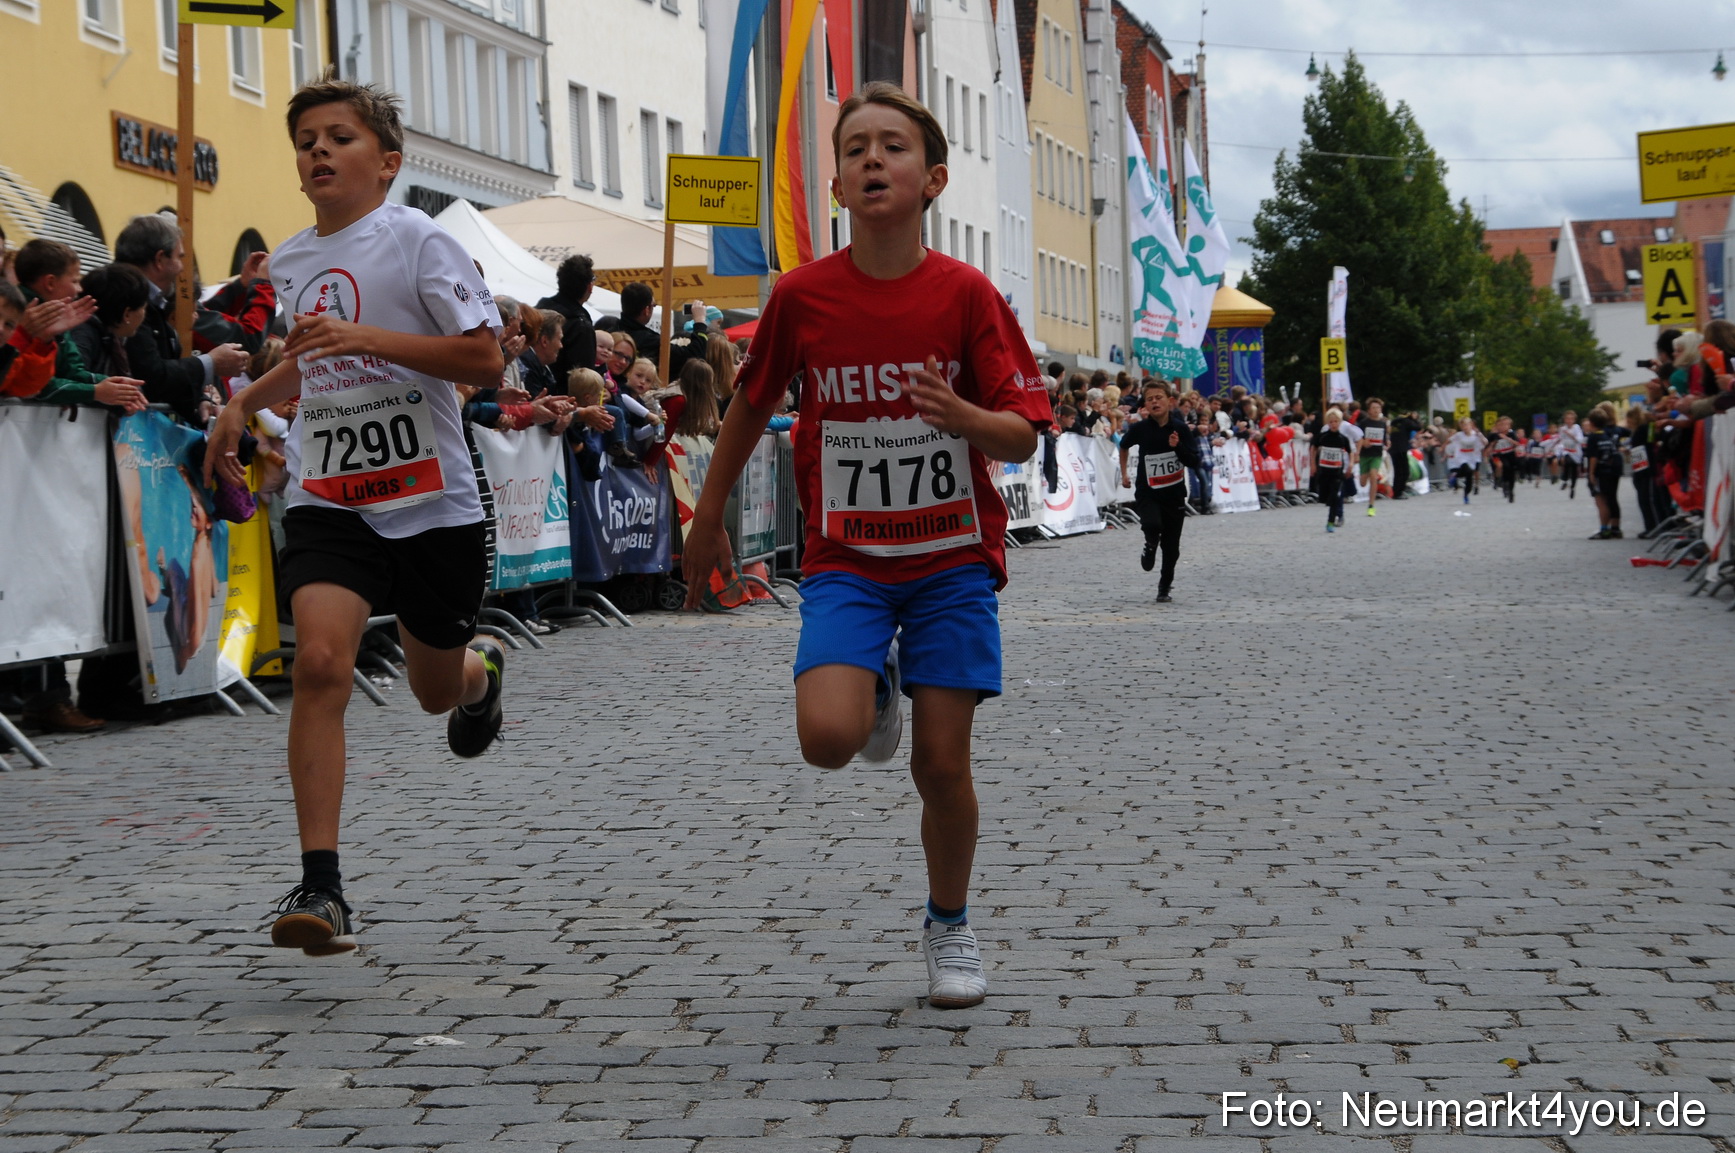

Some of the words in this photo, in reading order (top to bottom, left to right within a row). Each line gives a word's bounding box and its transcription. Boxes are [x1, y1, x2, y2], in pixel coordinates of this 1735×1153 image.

[1645, 145, 1735, 166] Schnupper-
[1677, 166, 1708, 182] lauf
[673, 174, 753, 193] Schnupper-
[700, 195, 726, 209] lauf
[1649, 248, 1694, 263] Block
[1657, 268, 1688, 307] A
[1328, 348, 1339, 365] B
[334, 360, 356, 373] MIT
[343, 379, 358, 389] Dr.
[303, 406, 335, 422] PARTL
[335, 396, 401, 418] Neumarkt
[313, 414, 420, 475] 7290
[825, 434, 871, 449] PARTL
[875, 430, 944, 449] Neumarkt
[425, 448, 434, 456] M
[1150, 460, 1180, 477] 7163
[837, 450, 956, 507] 7178
[342, 478, 401, 501] Lukas
[960, 487, 969, 496] M
[830, 500, 836, 508] 6
[843, 512, 960, 540] Maximilian
